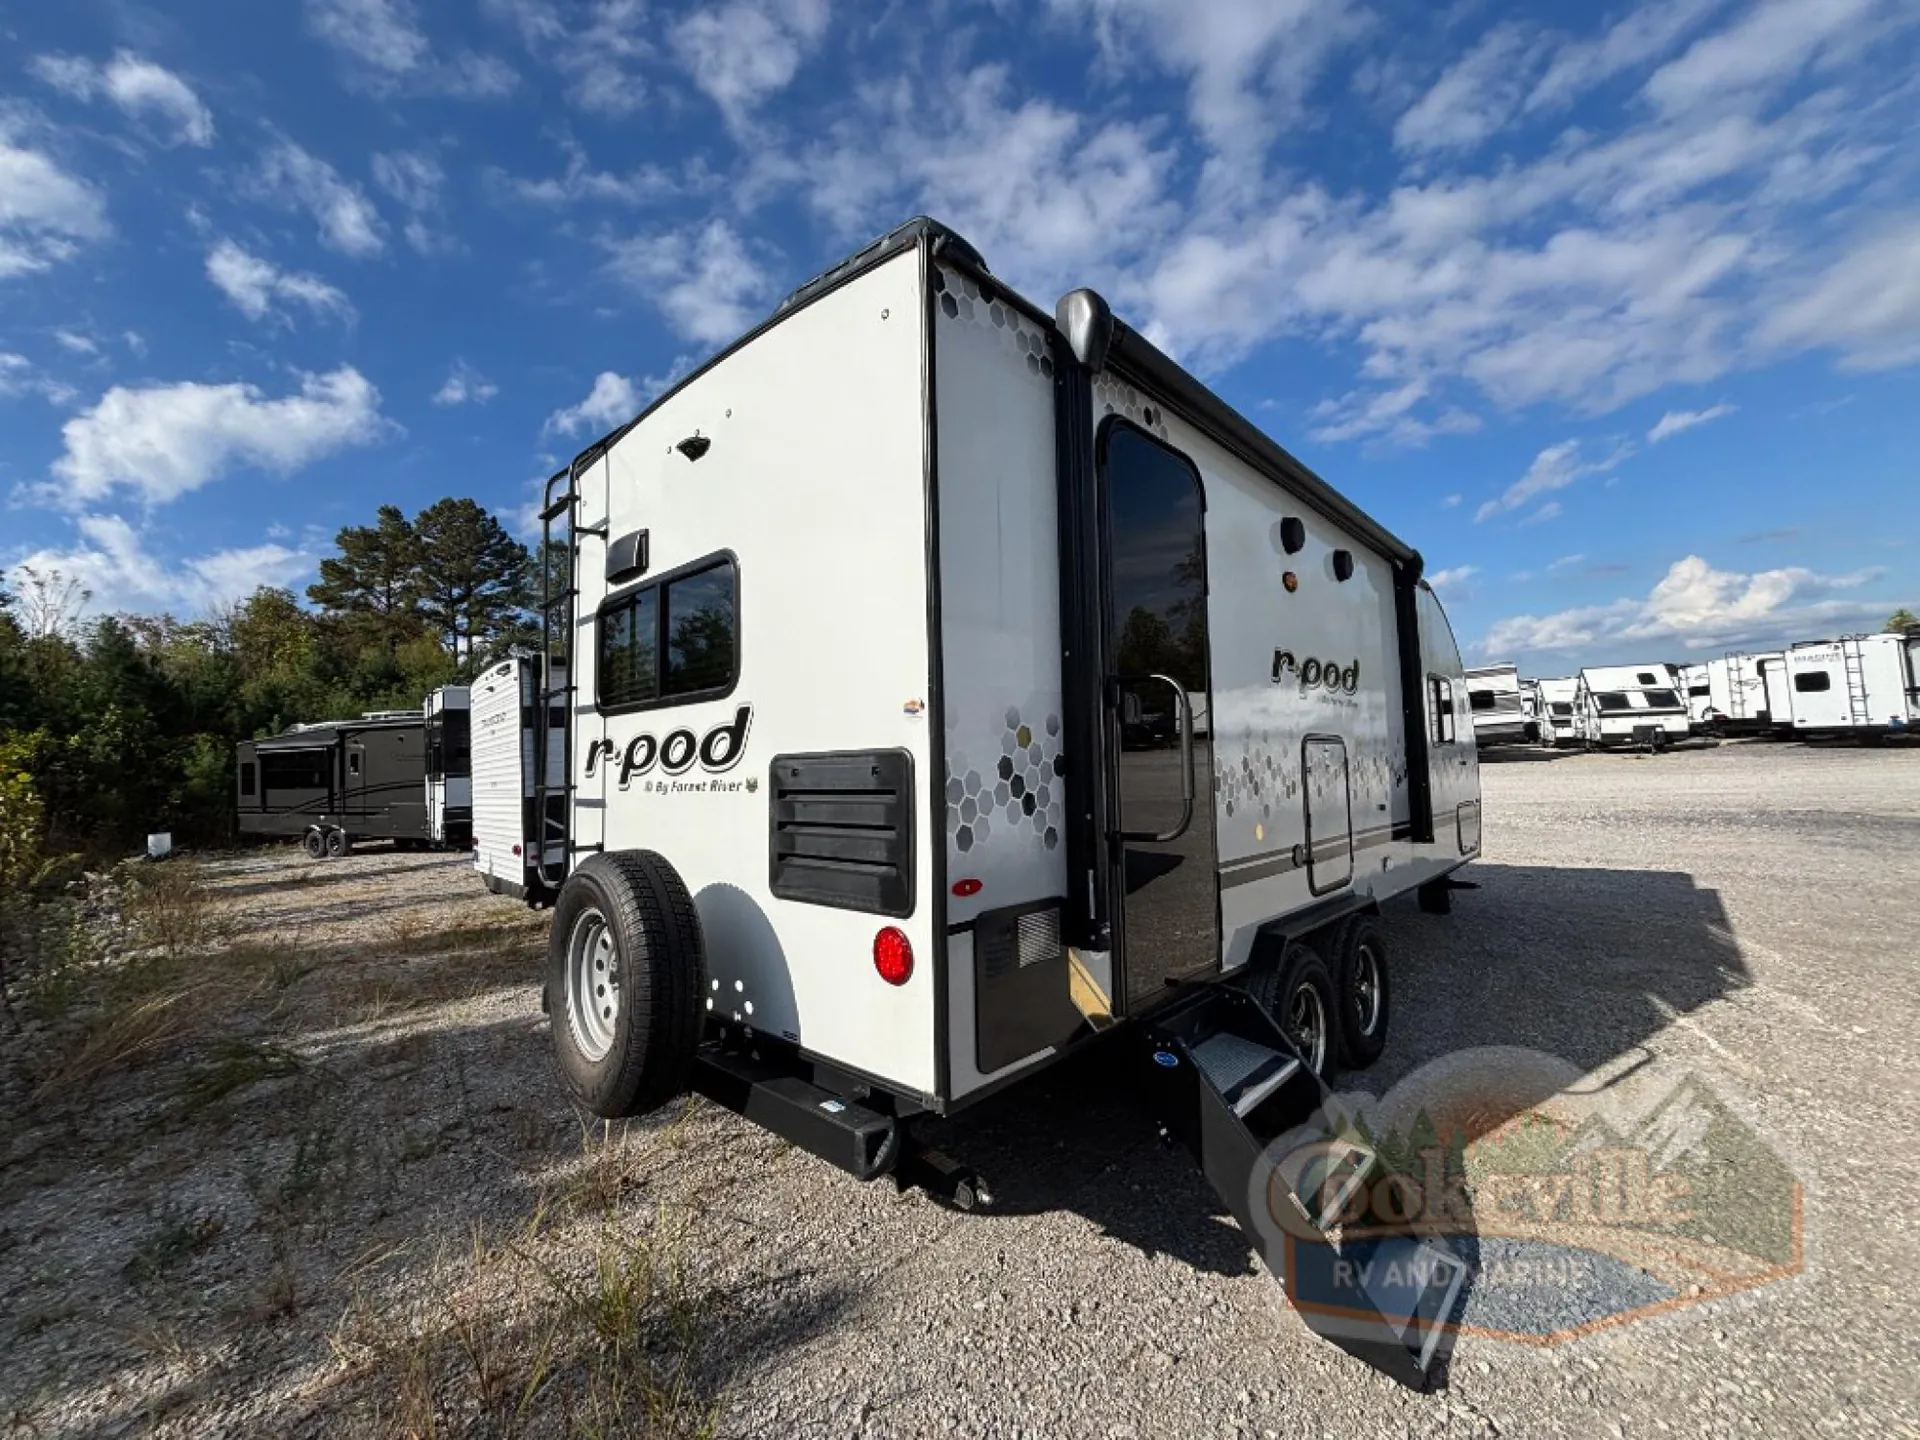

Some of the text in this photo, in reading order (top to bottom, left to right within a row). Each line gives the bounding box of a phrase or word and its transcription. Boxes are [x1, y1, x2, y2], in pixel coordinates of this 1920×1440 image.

[655, 779, 743, 796] By Forest River
